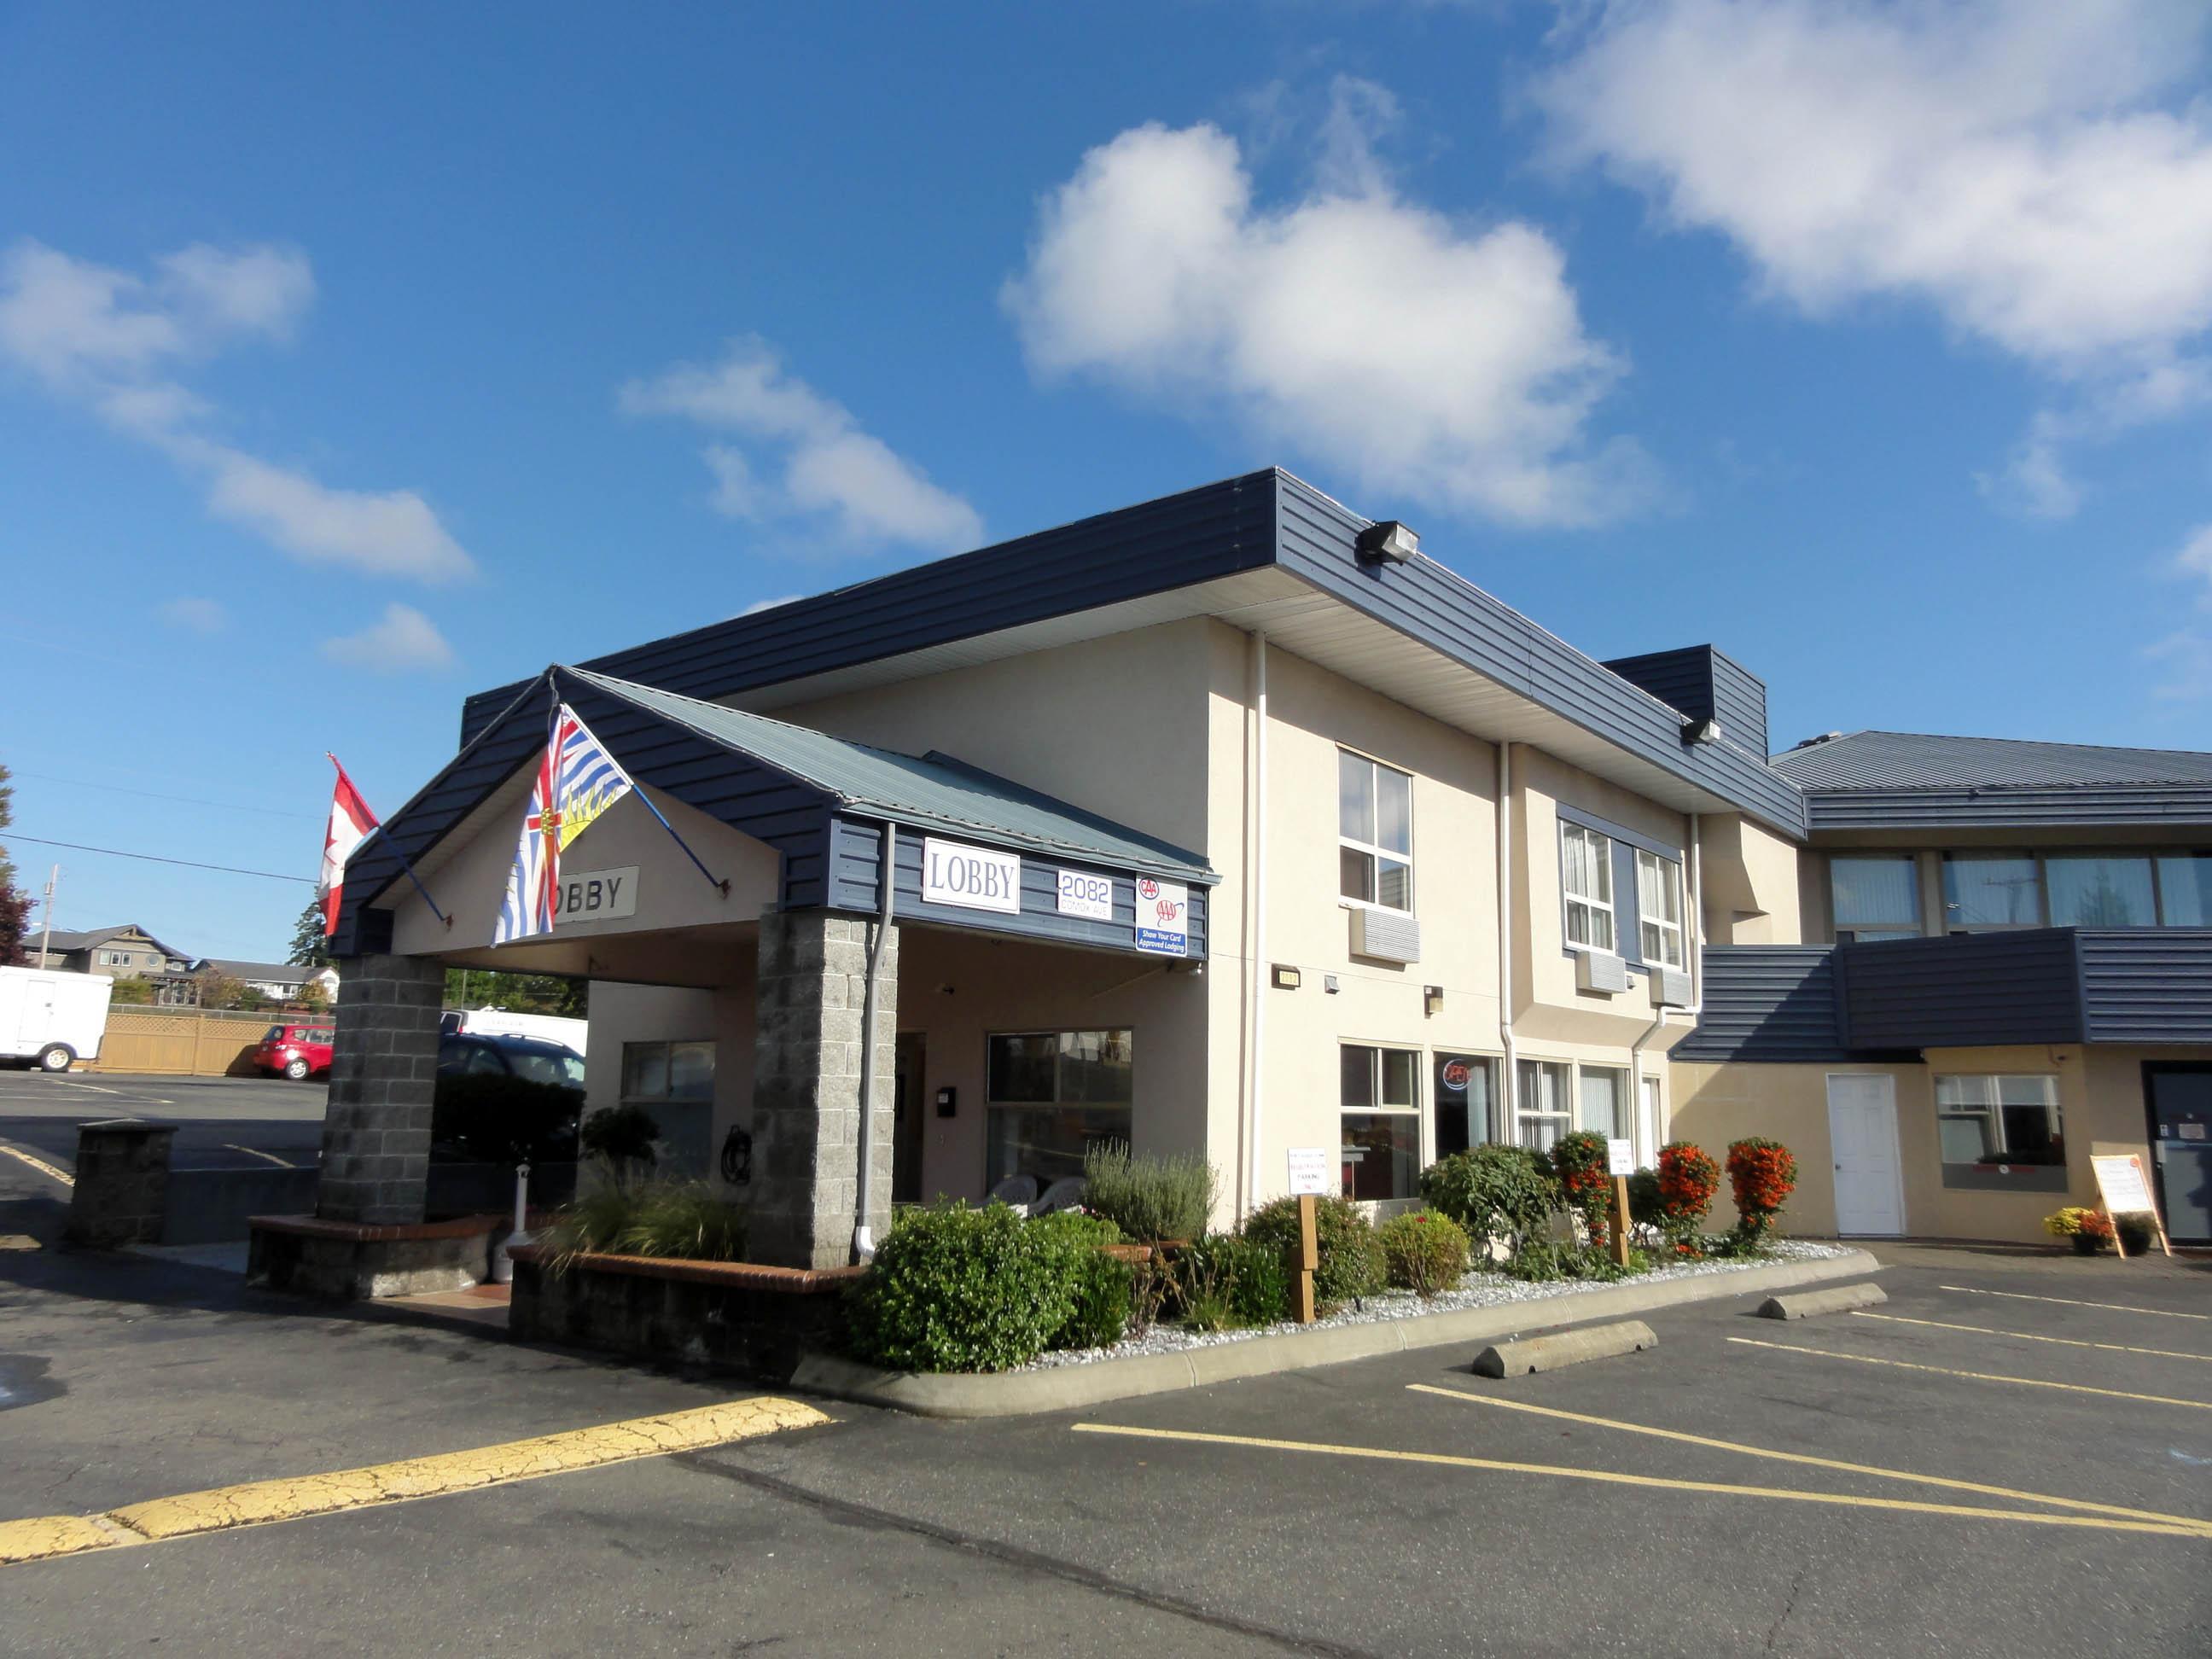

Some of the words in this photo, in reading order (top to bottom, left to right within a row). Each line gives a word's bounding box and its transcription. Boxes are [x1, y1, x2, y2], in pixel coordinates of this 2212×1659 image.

[931, 853, 1015, 899] LOBBY
[554, 876, 622, 915] BBY
[1062, 875, 1109, 904] 2082
[1141, 879, 1156, 896] CAA
[1157, 900, 1176, 920] AAA
[1138, 938, 1164, 948] Approved
[1164, 941, 1185, 953] Lodging
[1142, 929, 1157, 939] Show
[1157, 931, 1169, 940] Your
[1169, 934, 1182, 942] Card
